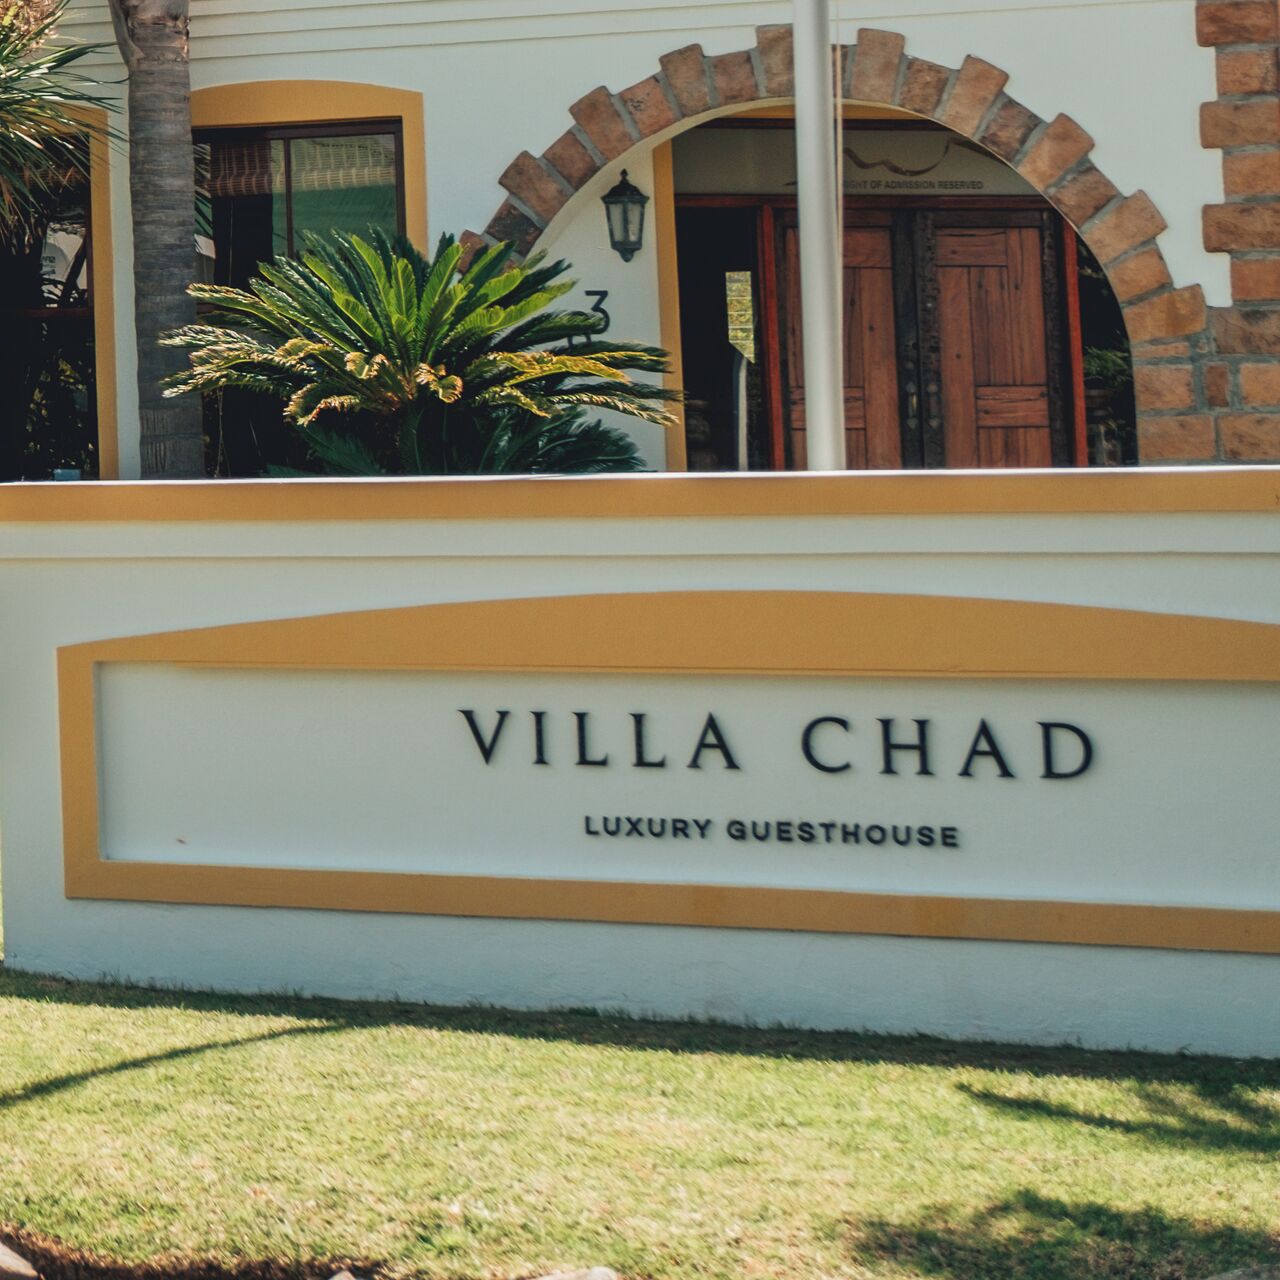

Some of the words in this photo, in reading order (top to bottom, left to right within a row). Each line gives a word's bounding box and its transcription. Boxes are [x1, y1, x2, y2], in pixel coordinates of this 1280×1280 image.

[870, 180, 882, 189] OF
[884, 180, 935, 189] ADMISSION
[937, 180, 983, 189] RESERVED
[457, 709, 742, 770] VILLA
[800, 716, 1095, 780] CHAD
[585, 816, 712, 840] LUXURY
[727, 821, 961, 848] GUESTHOUSE
